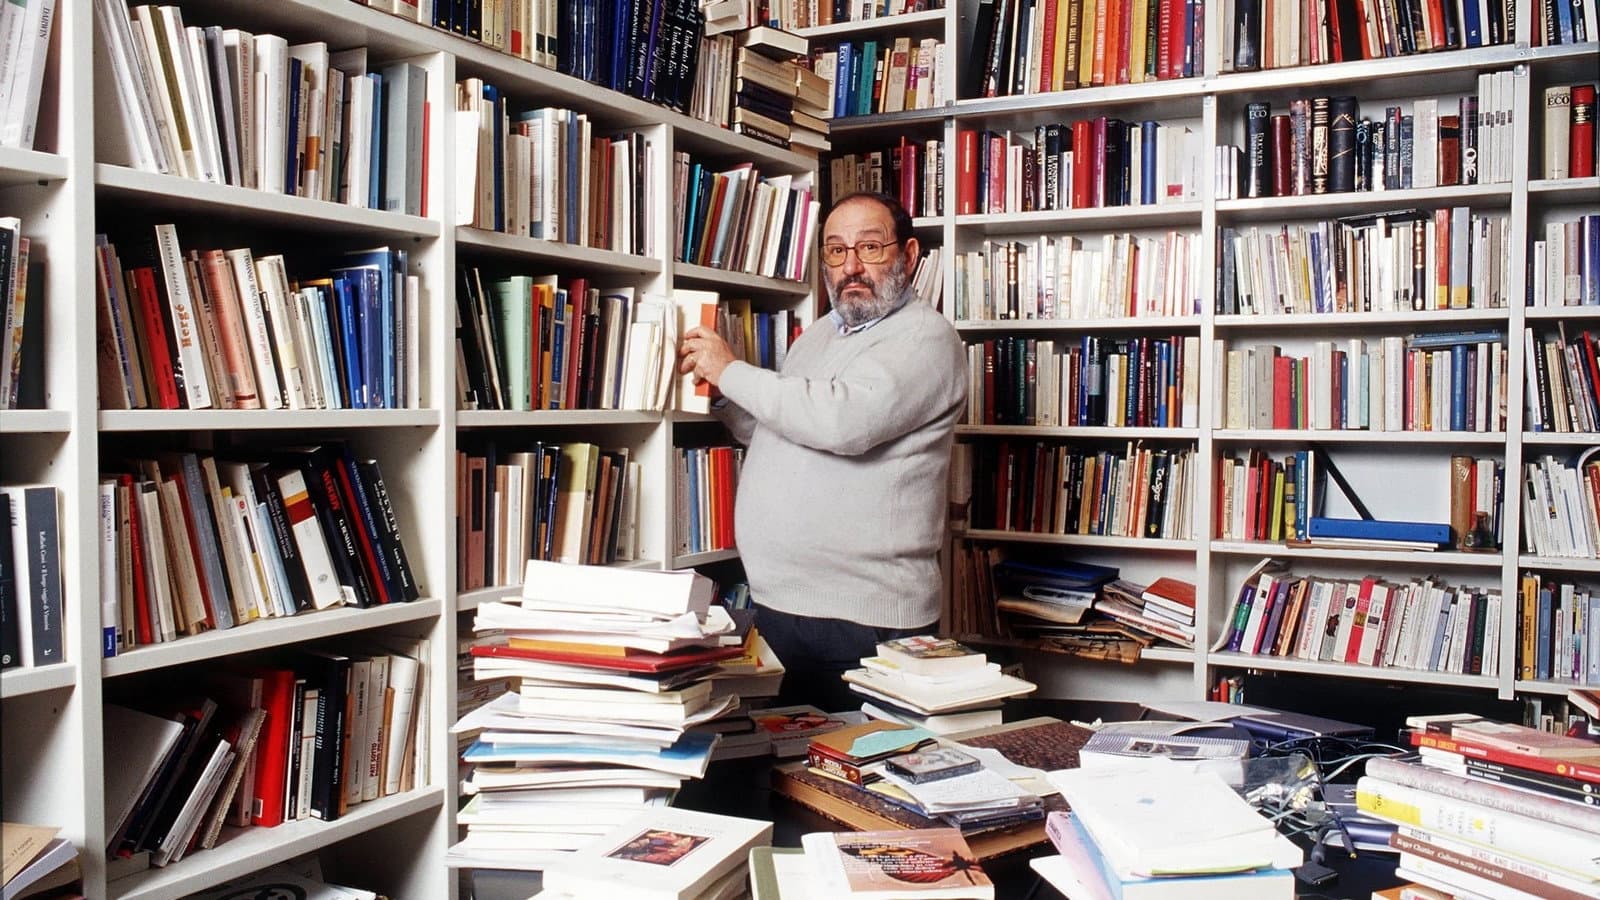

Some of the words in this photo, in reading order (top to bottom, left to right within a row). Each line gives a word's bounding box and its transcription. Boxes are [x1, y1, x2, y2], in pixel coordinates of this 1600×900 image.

[39, 7, 50, 39] DARWIN
[1545, 5, 1554, 40] EUGENIO
[670, 26, 682, 58] Umberto
[682, 29, 693, 62] Umberto
[840, 45, 848, 63] ECO
[668, 60, 677, 75] Eco
[680, 63, 688, 79] Eco
[1250, 111, 1267, 120] ECO
[1547, 96, 1569, 106] ECO
[162, 230, 175, 268] Assouline
[170, 271, 181, 296] Pierre
[249, 283, 262, 319] BENCIVENGA
[179, 303, 194, 348] Hergé
[378, 479, 401, 541] CALVINO
[341, 526, 355, 556] BENDAZZI
[40, 587, 48, 604] viaggio
[1395, 838, 1412, 849] Roger
[1412, 843, 1435, 855] Chartier
[1436, 851, 1460, 864] Cultura
[1459, 859, 1477, 870] scritta
